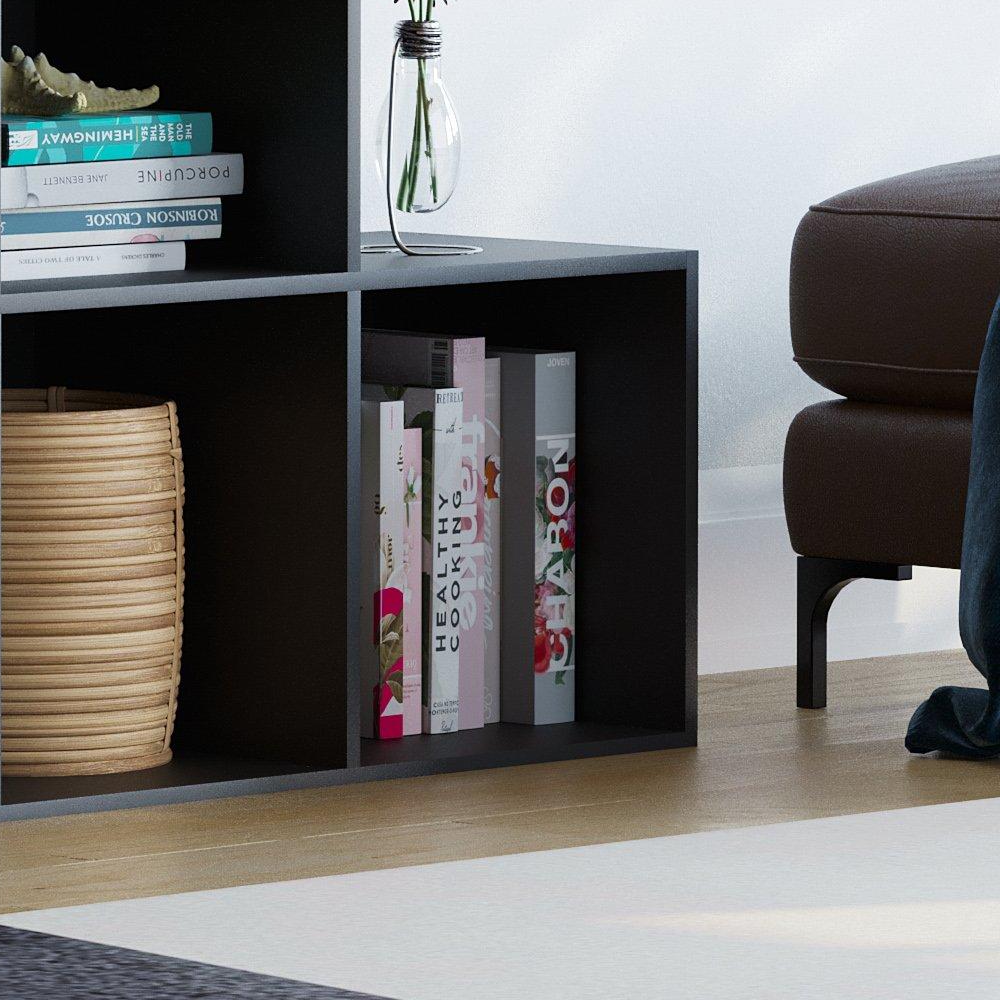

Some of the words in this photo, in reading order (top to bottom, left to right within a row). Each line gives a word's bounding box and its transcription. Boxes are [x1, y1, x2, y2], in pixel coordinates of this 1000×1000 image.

[42, 129, 133, 145] HEMINGWAY
[140, 126, 148, 142] SEA
[176, 123, 184, 141] OLD
[43, 175, 84, 186] BENNETT
[87, 174, 108, 184] JANE
[138, 166, 230, 183] PORCUPINE
[85, 211, 142, 227] CRUSOE
[146, 208, 218, 224] ROBINSON
[546, 357, 570, 367] JOVEN
[459, 414, 485, 630] frankie
[546, 439, 571, 668] CHABON
[435, 493, 449, 652] HEALTHY
[450, 490, 462, 652] COOKING
